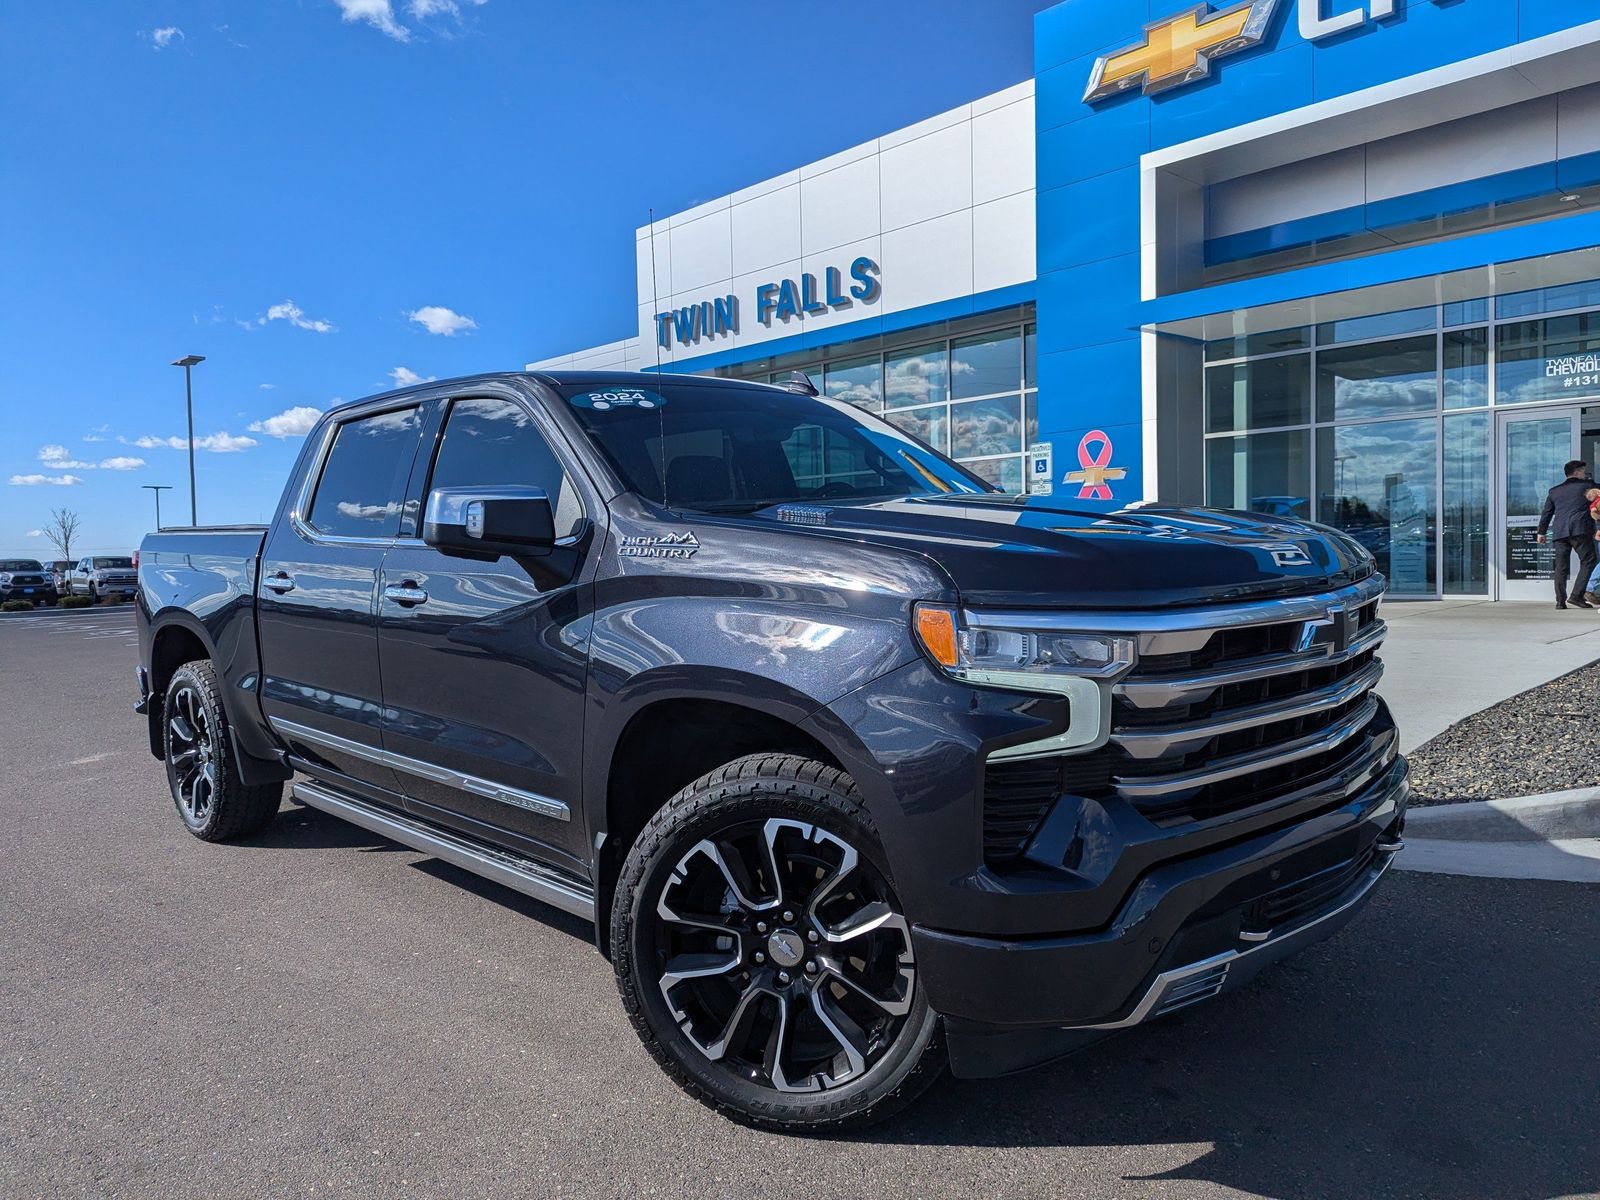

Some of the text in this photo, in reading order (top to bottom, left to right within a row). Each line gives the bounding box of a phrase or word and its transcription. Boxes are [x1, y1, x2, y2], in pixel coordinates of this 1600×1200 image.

[653, 256, 882, 351] TWIN FALLS
[588, 392, 646, 401] 2024
[620, 535, 657, 546] HIGH
[617, 547, 698, 559] COUNTRY
